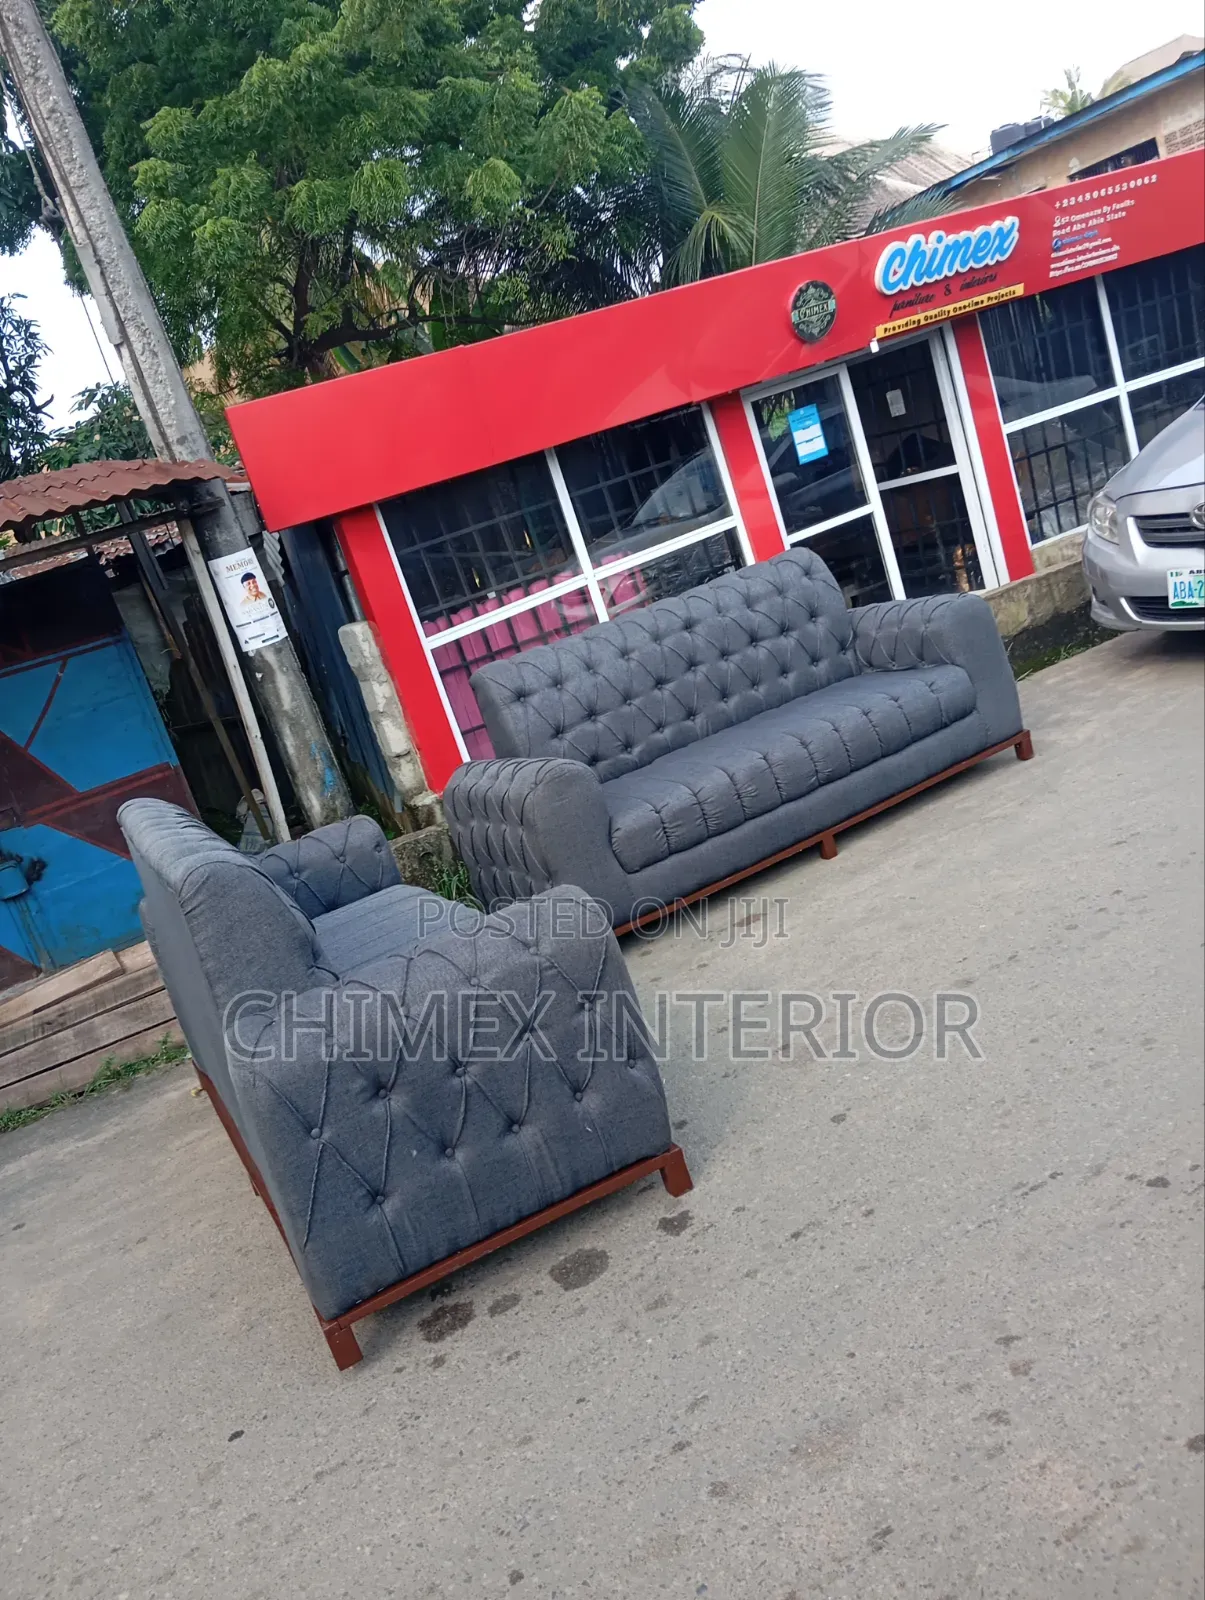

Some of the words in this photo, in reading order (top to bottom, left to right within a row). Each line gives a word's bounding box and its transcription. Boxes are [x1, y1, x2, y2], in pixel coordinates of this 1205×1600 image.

[1102, 205, 1112, 214] By
[1105, 210, 1127, 222] State
[876, 216, 1019, 295] Chimex
[943, 283, 952, 297] &
[799, 301, 829, 320] CHIMEX
[883, 318, 922, 334] Providing
[923, 308, 952, 321] Quality
[986, 289, 1017, 303] Projects
